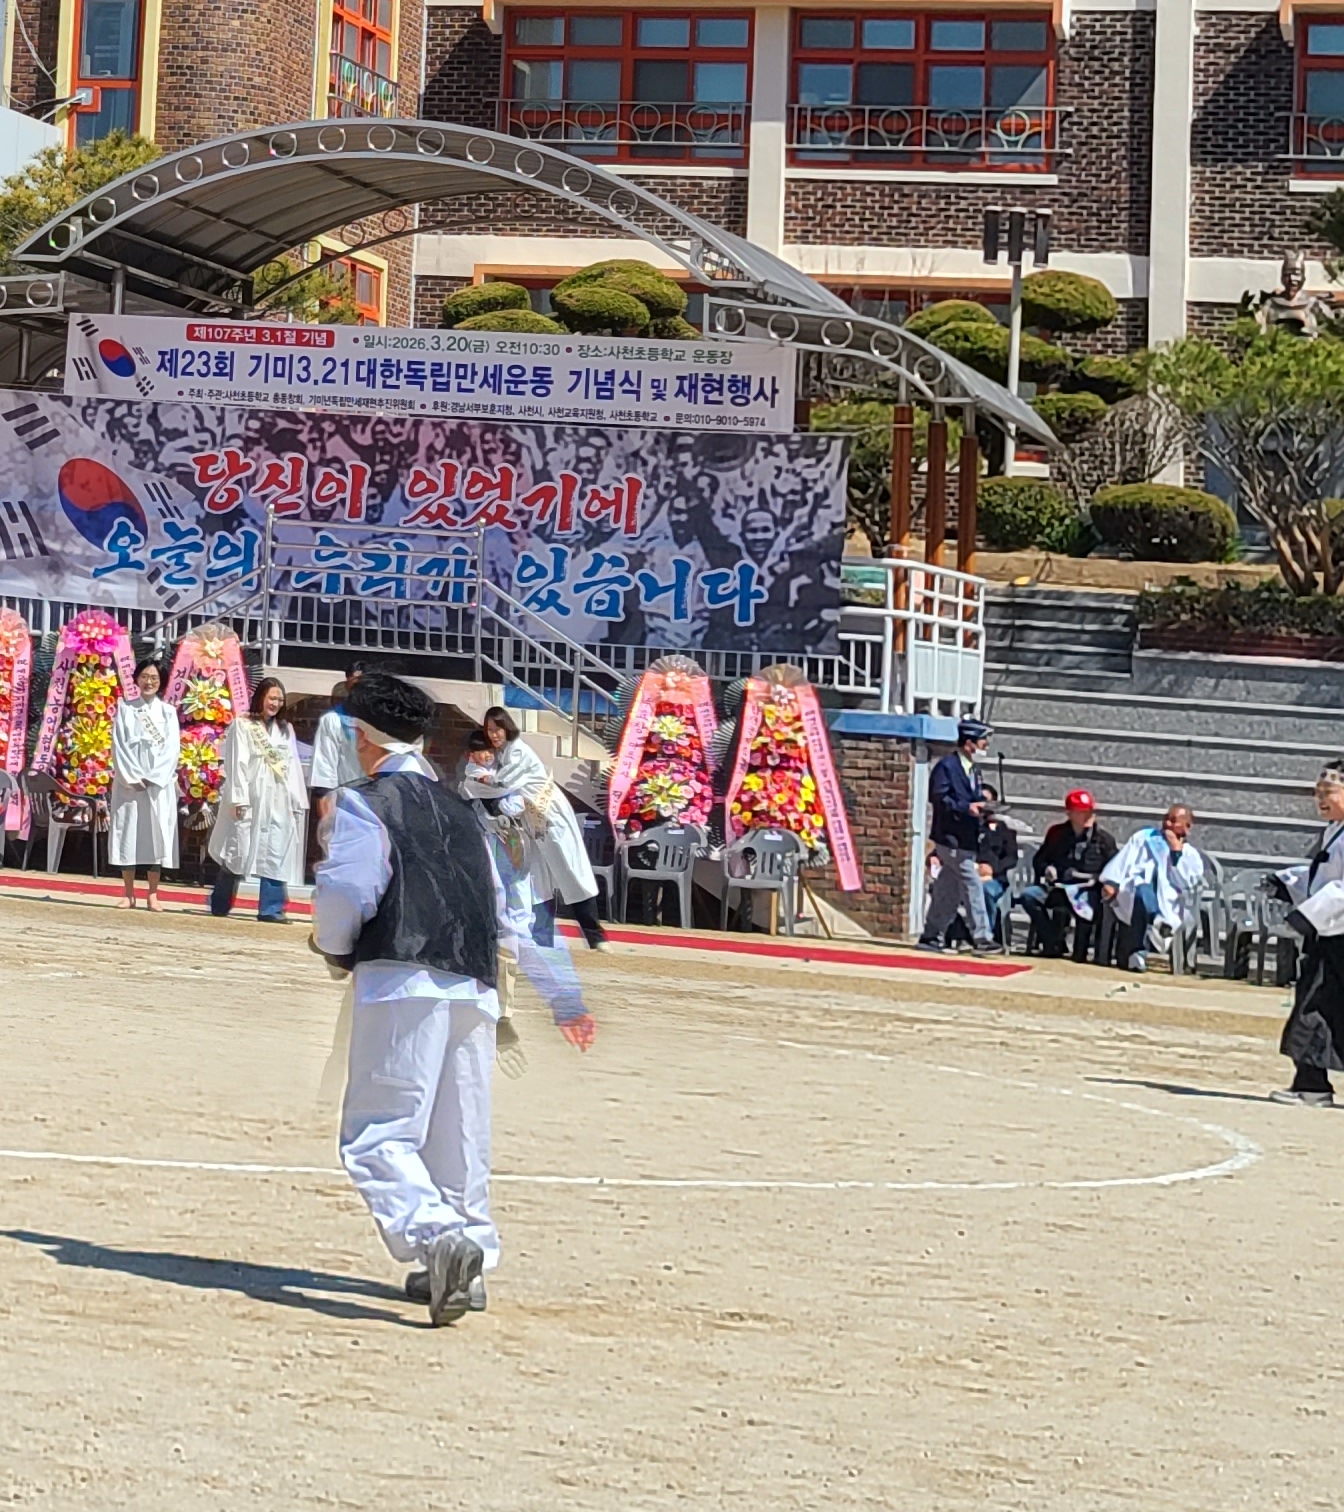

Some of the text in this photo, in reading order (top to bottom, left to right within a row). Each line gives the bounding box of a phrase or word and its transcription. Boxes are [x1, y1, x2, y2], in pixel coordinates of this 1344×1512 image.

[193, 326, 328, 346] 제107주년 3.1절 기념
[363, 334, 560, 357] 일시:2026.3.20(금) 오전10:30
[577, 344, 734, 366] 장소:사천초등학교 운동장
[156, 348, 780, 409] 제23회 기미3.21대한독립만세운동 기념식 및 재현행사
[609, 409, 658, 423] 사천초등학교
[675, 413, 766, 428] 문의:010-9010-5974
[192, 449, 643, 535] 당신이 있었기에
[92, 519, 764, 624] 오늘의 우리가 있습니다
